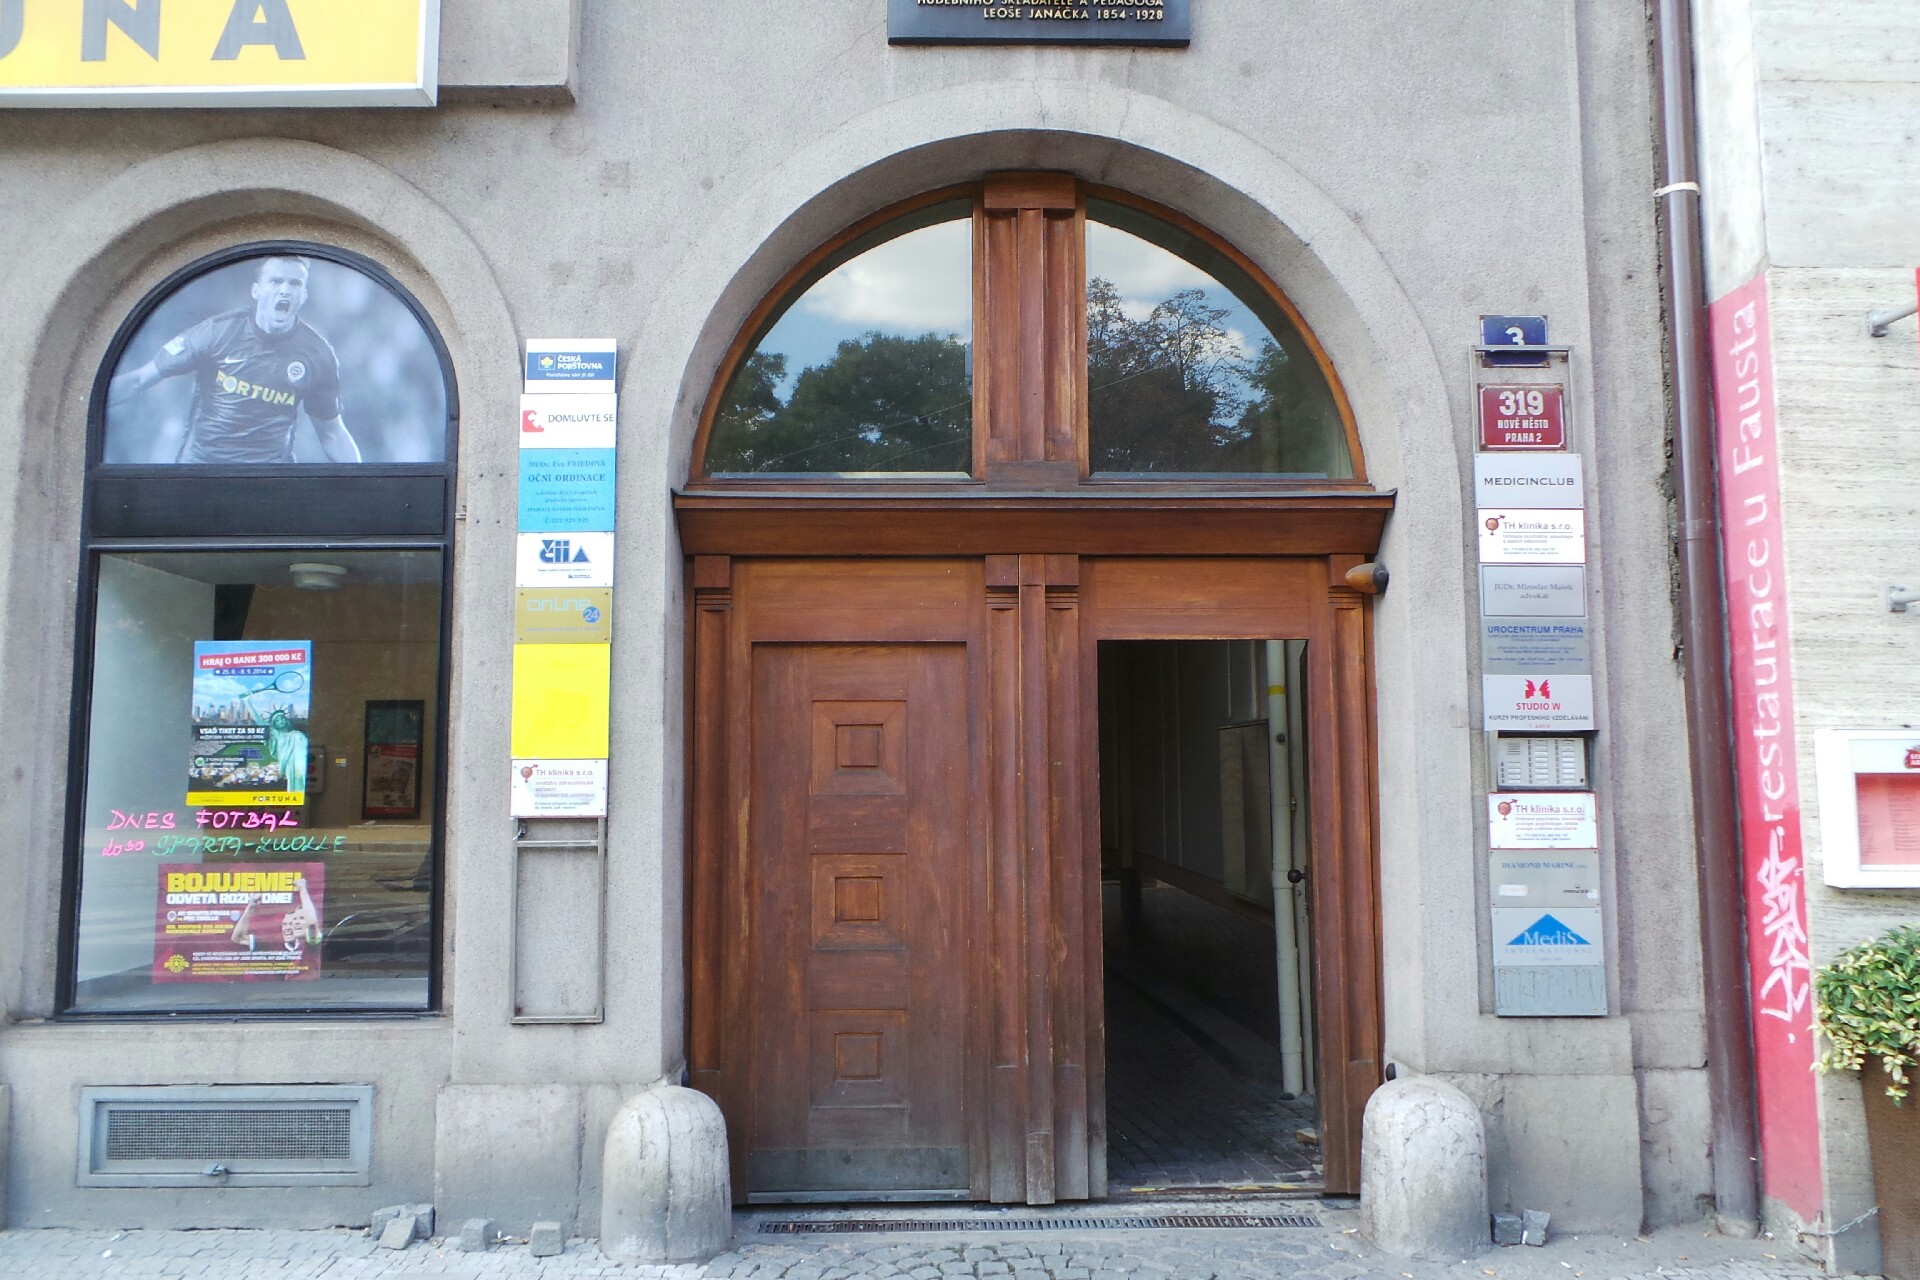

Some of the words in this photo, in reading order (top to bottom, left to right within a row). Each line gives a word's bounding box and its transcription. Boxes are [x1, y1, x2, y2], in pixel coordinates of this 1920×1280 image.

[983, 5, 1022, 19] LEOŠE
[1028, 6, 1089, 20] JANÁČKA
[1504, 326, 1526, 346] 3
[557, 354, 582, 363] ČESKÁ
[215, 369, 296, 406] FORTUNA
[1729, 300, 1764, 476] Fausta
[1499, 390, 1544, 416] 319
[548, 414, 601, 423] DOMLUVTE
[604, 413, 614, 422] SE
[1497, 417, 1520, 429] NOVÉ
[1522, 417, 1549, 429] MĚSTO
[1505, 433, 1534, 443] PRAHA
[1536, 433, 1542, 442] 2
[528, 473, 552, 482] OČNÍ
[555, 473, 606, 482] ORDINACE
[1484, 477, 1575, 486] MEDICINCLUB
[1744, 493, 1768, 527] u
[1503, 522, 1515, 530] TH
[1518, 521, 1548, 530] klinika
[584, 609, 598, 621] 24
[1487, 626, 1551, 634] UROCENTRUM
[1552, 626, 1584, 634] PRAHA
[202, 658, 224, 667] HRAJ
[224, 657, 232, 665] O
[233, 656, 257, 664] BANK
[258, 655, 273, 663] 300
[1747, 537, 1786, 823] restaurace
[1516, 702, 1549, 711] STUDIO
[1552, 702, 1560, 711] W
[1515, 805, 1528, 813] TH
[1530, 804, 1560, 813] klinika
[107, 810, 176, 830] DNES
[196, 810, 298, 832] FOTBAL
[167, 872, 302, 893] BOJUJEME!
[166, 893, 218, 905] ODVETA
[1523, 930, 1577, 945] MediS
